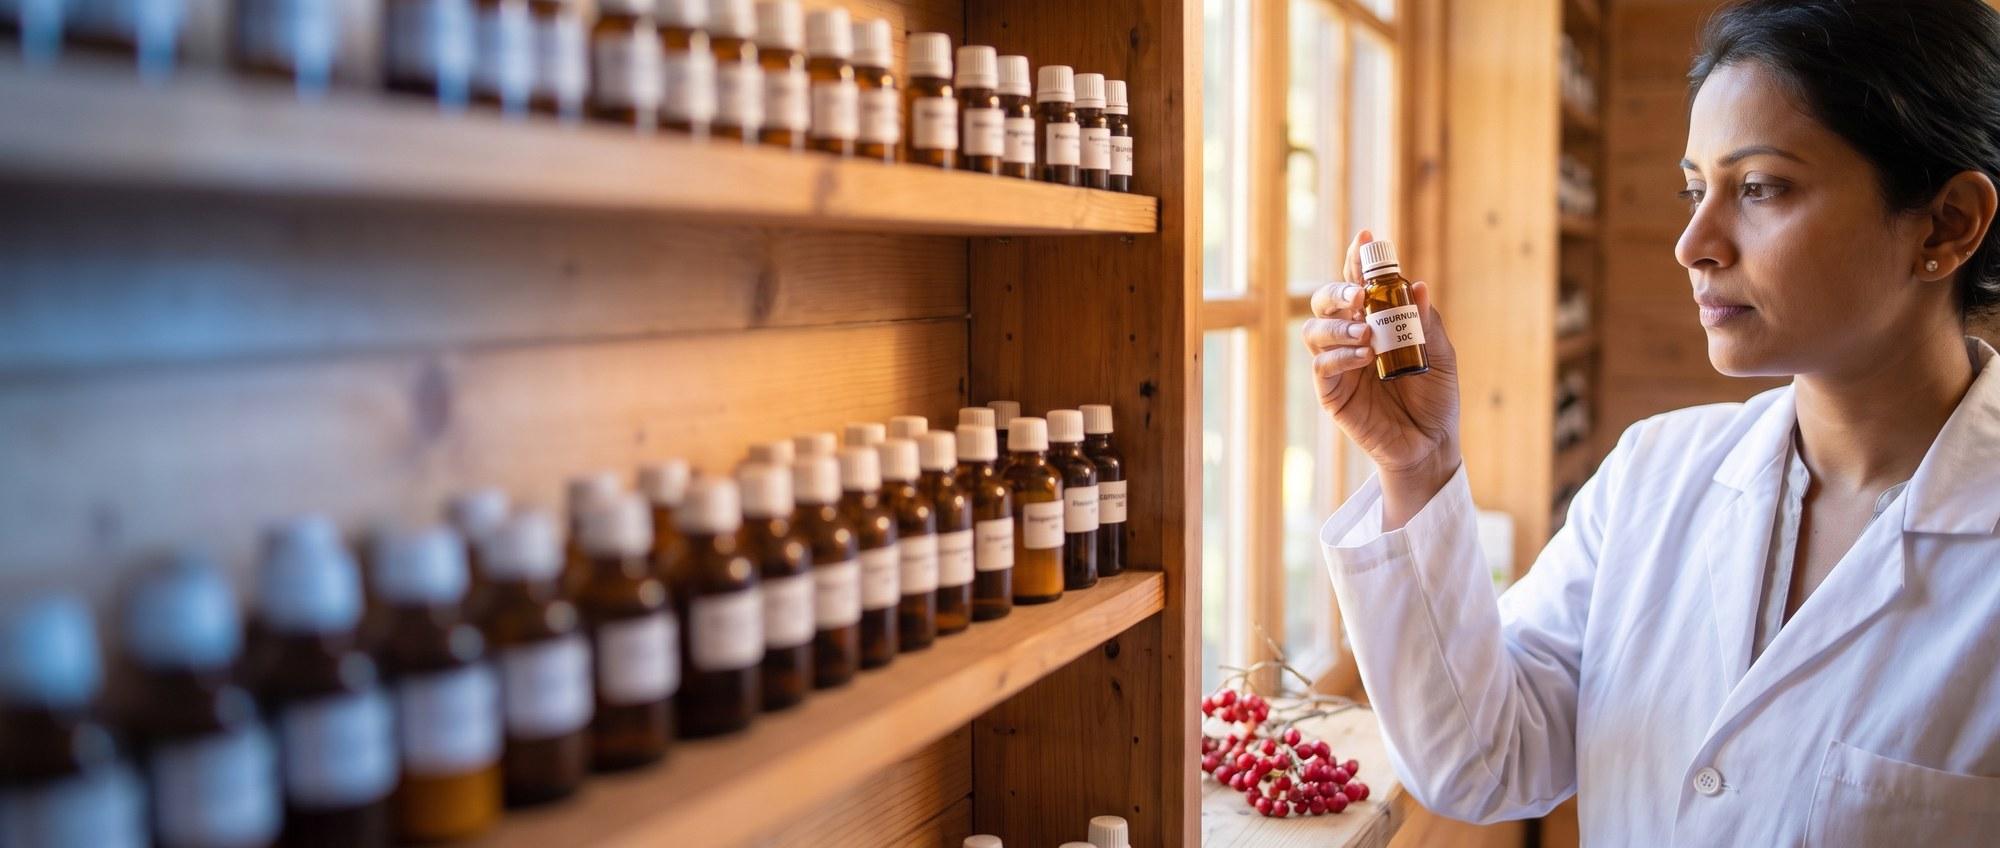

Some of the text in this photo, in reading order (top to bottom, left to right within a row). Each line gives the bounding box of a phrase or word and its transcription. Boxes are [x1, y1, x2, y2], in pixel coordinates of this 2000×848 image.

[1376, 312, 1417, 326] VIBURNUM
[1395, 323, 1407, 332] OP
[1396, 333, 1413, 342] 30C
